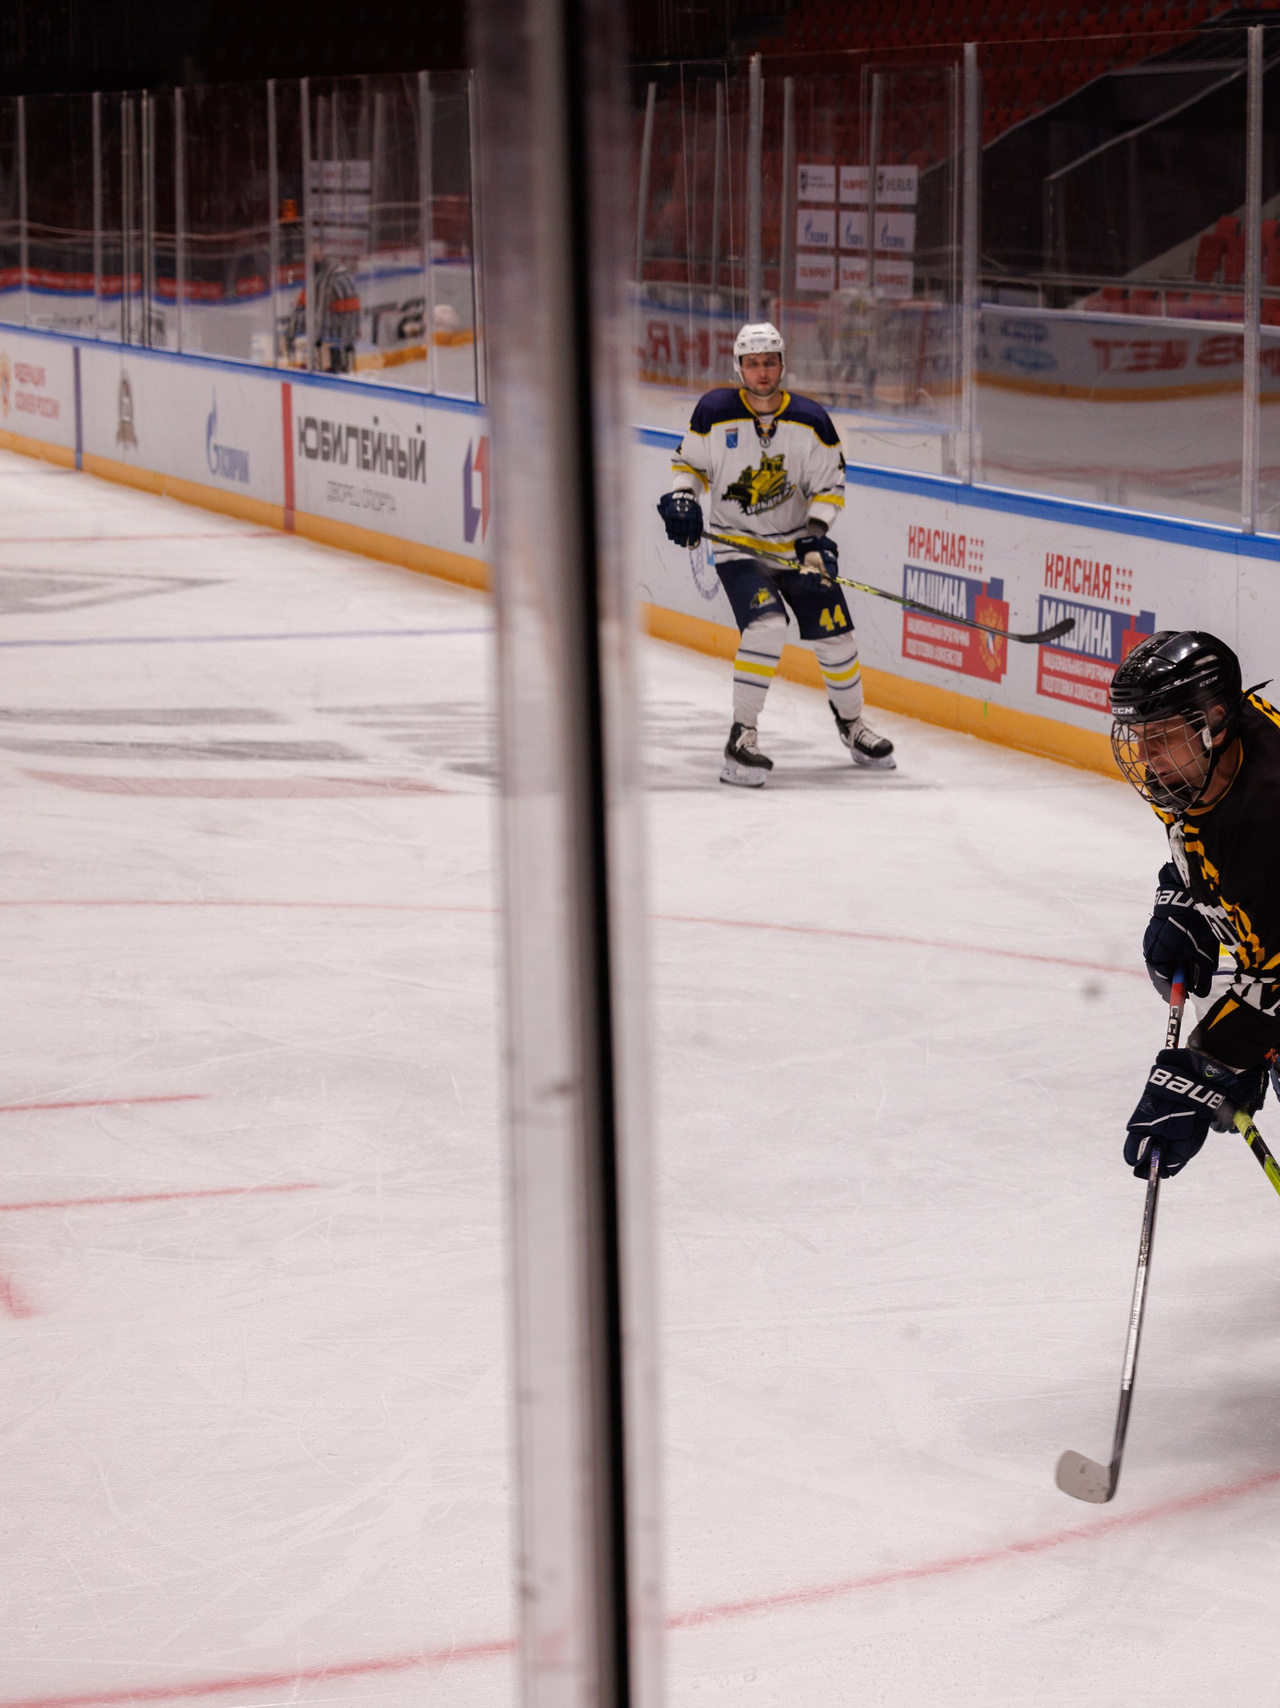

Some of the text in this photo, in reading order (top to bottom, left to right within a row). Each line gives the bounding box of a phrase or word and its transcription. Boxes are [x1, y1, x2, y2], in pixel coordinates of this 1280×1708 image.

[298, 415, 427, 484] ЮБИЛЕЙНЫЙ
[908, 524, 966, 569] КРАСНАЯ
[906, 567, 967, 620] МАШИНА
[1044, 552, 1112, 600] КРАСНАЯ
[819, 604, 847, 631] 44
[1042, 598, 1112, 659] МАШИНА
[1199, 676, 1218, 688] CCM
[1111, 706, 1134, 715] CCM
[1165, 1005, 1180, 1050] CCM
